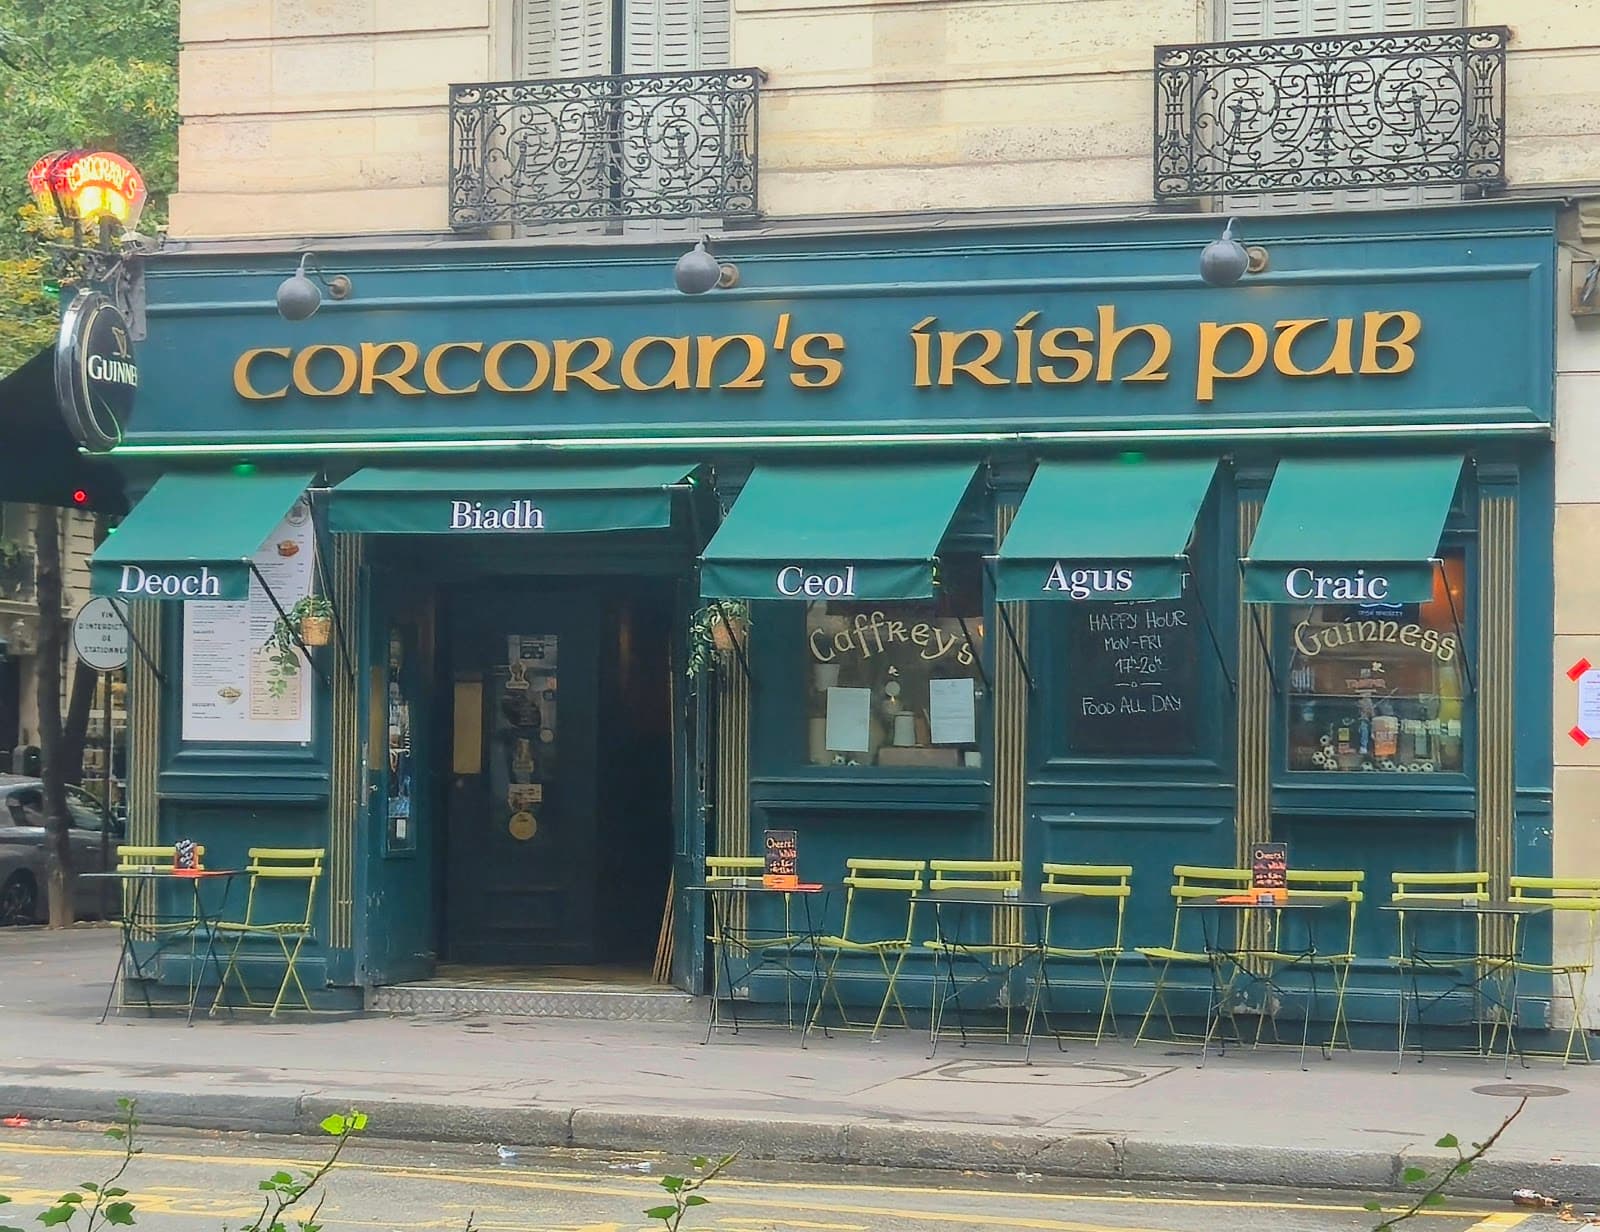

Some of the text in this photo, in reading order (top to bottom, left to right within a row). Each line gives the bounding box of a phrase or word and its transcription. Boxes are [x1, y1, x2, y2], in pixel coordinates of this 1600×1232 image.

[88, 354, 138, 388] GUINNE
[449, 499, 545, 530] Biadh
[117, 564, 221, 597] Deoch
[776, 565, 856, 597] Ceol
[1042, 560, 1133, 600] Agus
[1285, 566, 1388, 600] Craic
[1089, 612, 1137, 632] HAPPY
[1120, 696, 1146, 714] ALL
[1152, 694, 1181, 713] DAY
